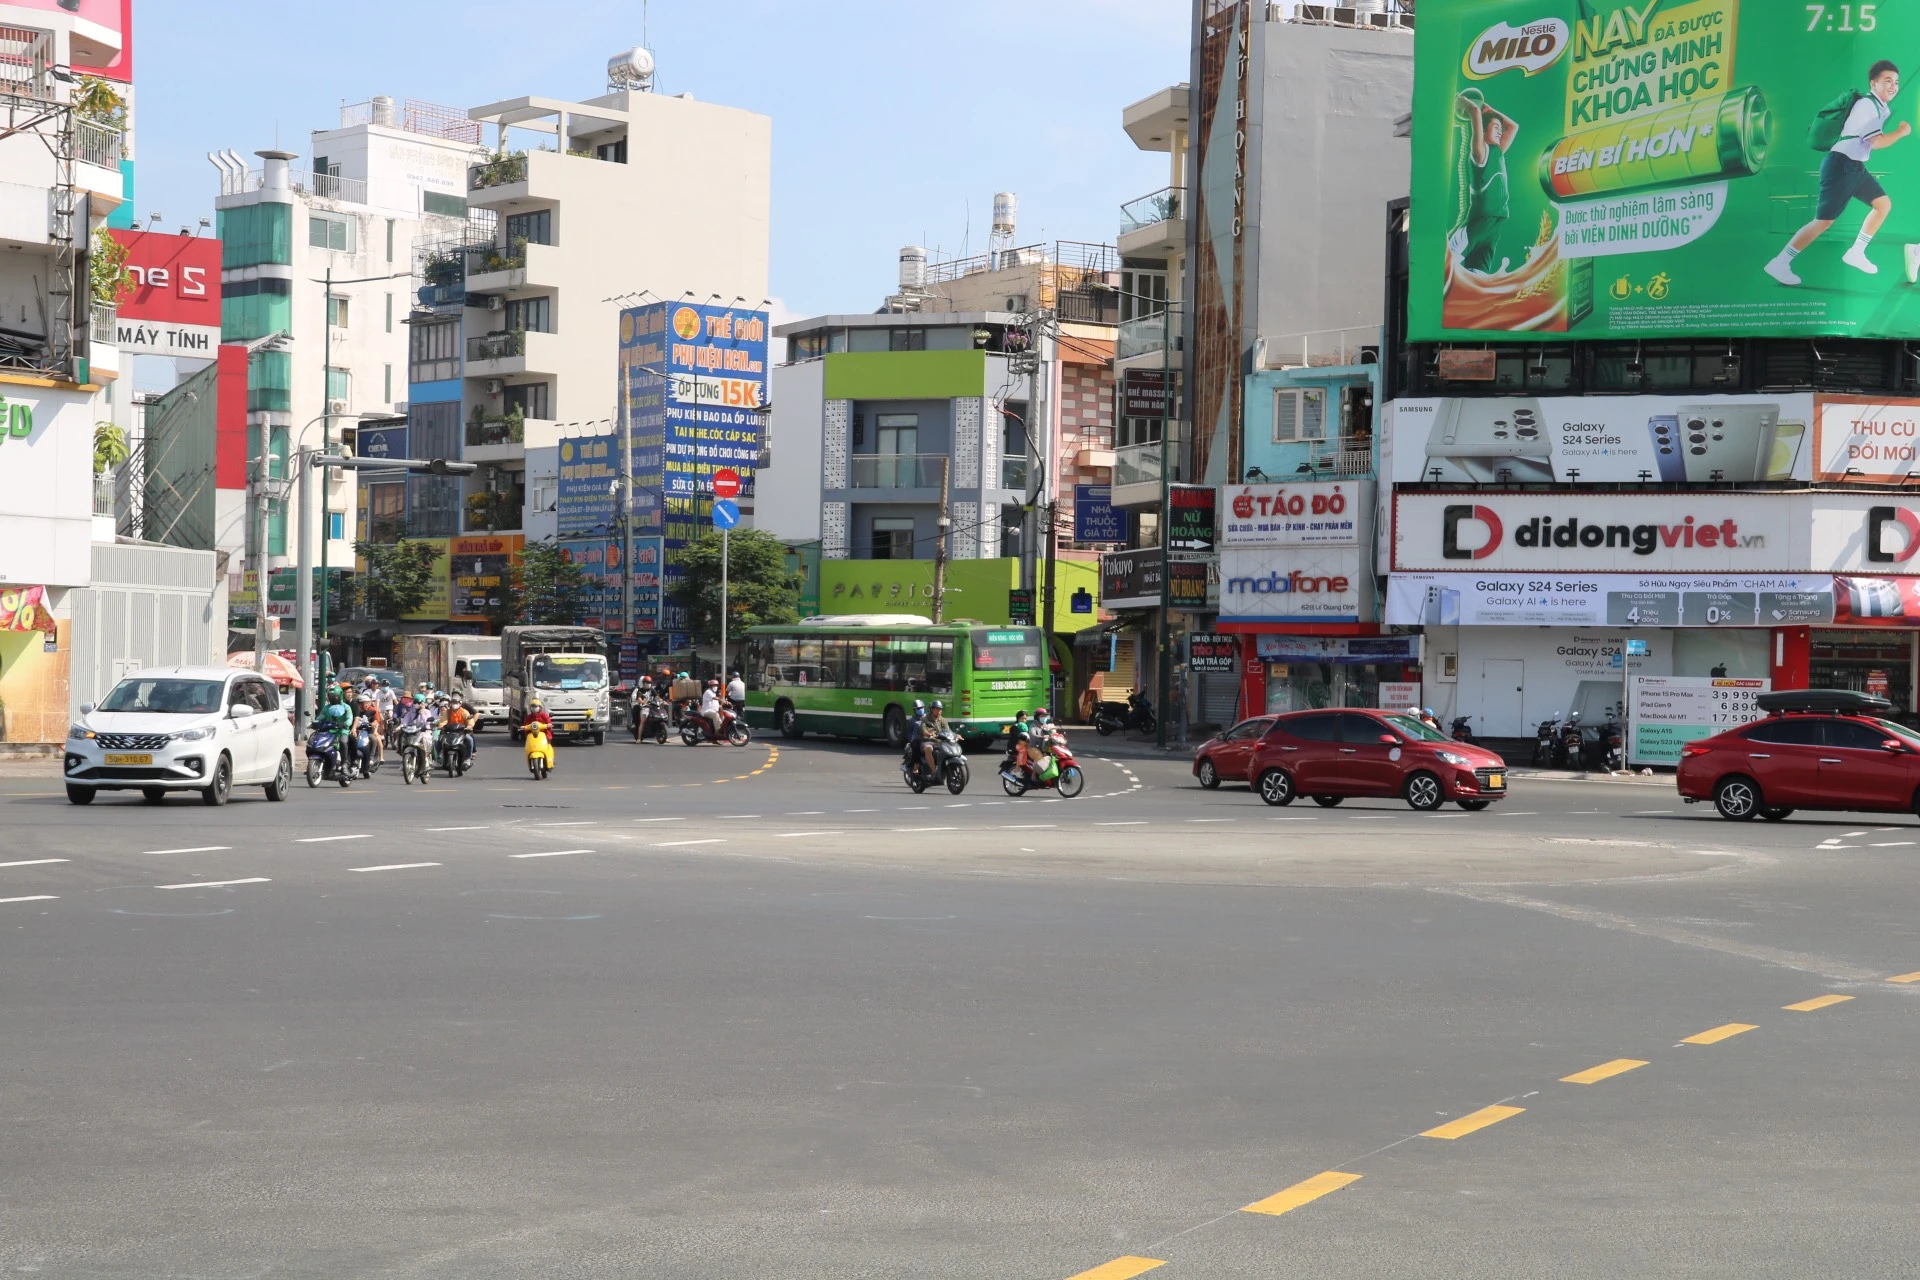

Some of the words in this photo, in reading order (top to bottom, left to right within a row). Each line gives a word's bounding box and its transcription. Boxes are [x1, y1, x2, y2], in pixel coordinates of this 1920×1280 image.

[1654, 21, 1676, 43] ĐÃ
[1677, 11, 1723, 34] ĐƯỢC
[1806, 5, 1876, 32] 7:15
[1521, 23, 1557, 36] Nestlé
[1574, 0, 1659, 62] NAY
[1477, 34, 1557, 65] MILO
[1572, 52, 1657, 93] CHỨNG
[1662, 32, 1723, 69] MINH
[1571, 81, 1653, 127] KHOA
[1658, 62, 1720, 104] HỌC
[1609, 198, 1650, 223] nghiệm
[1652, 196, 1677, 214] lâm
[1680, 191, 1714, 212] sàng
[1581, 223, 1605, 246] VIỆN
[1608, 223, 1638, 242] DINH
[705, 312, 734, 339] THẾ
[734, 316, 764, 342] GIỚI
[117, 325, 160, 346] MÁY
[166, 328, 209, 350] TÍNH
[672, 343, 695, 371] PHỤ
[696, 343, 723, 373] KIỆN
[720, 380, 757, 407] 15K
[666, 407, 683, 421] PHỤ
[703, 411, 720, 423] BAO
[721, 412, 733, 424] DA
[734, 411, 745, 425] ỐP
[674, 426, 688, 438] TAI
[725, 429, 740, 443] CÁP
[741, 432, 757, 445] SẠC
[1562, 422, 1605, 435] Galaxy
[1850, 420, 1886, 436] THU
[1890, 418, 1915, 437] CŨ
[666, 443, 677, 454] PIN
[1562, 435, 1582, 445] S24
[1585, 434, 1621, 445] Series
[1562, 448, 1590, 457] Galaxy
[1591, 448, 1600, 456] AI
[1609, 448, 1616, 456] is
[1617, 448, 1637, 456] here
[1848, 441, 1880, 460] ĐỔI
[1883, 443, 1916, 460] MỚI
[665, 460, 681, 472] MUA
[1091, 503, 1112, 514] NHÀ
[1256, 488, 1305, 517] TÁO
[1312, 485, 1346, 516] ĐỎ
[1085, 514, 1118, 526] THUỐC
[1084, 527, 1100, 538] GIÁ
[1101, 526, 1119, 538] TỐT
[1171, 524, 1213, 537] HOÀNG
[1515, 515, 1765, 555] didongviet.vn
[1228, 570, 1349, 594] mobifone
[1475, 580, 1525, 595] Galaxy
[1528, 581, 1552, 592] S24
[1555, 580, 1598, 592] Series
[1638, 579, 1650, 588] Sở
[1651, 579, 1668, 588] Hữu
[1668, 580, 1691, 589] Ngay
[1693, 579, 1711, 588] Siêu
[1712, 578, 1738, 588] Phẩm
[1323, 604, 1342, 613] Quang
[1486, 596, 1524, 607] Galaxy
[1525, 596, 1536, 606] AI
[1550, 596, 1559, 606] is
[1560, 596, 1587, 606] here
[1627, 606, 1640, 623] 4
[1706, 606, 1731, 624] 0%
[1788, 609, 1820, 617] Samsung
[1556, 646, 1598, 659] Galaxy
[1601, 647, 1621, 656] S24
[1565, 660, 1595, 668] Galaxy
[1640, 727, 1661, 735] Galaxy
